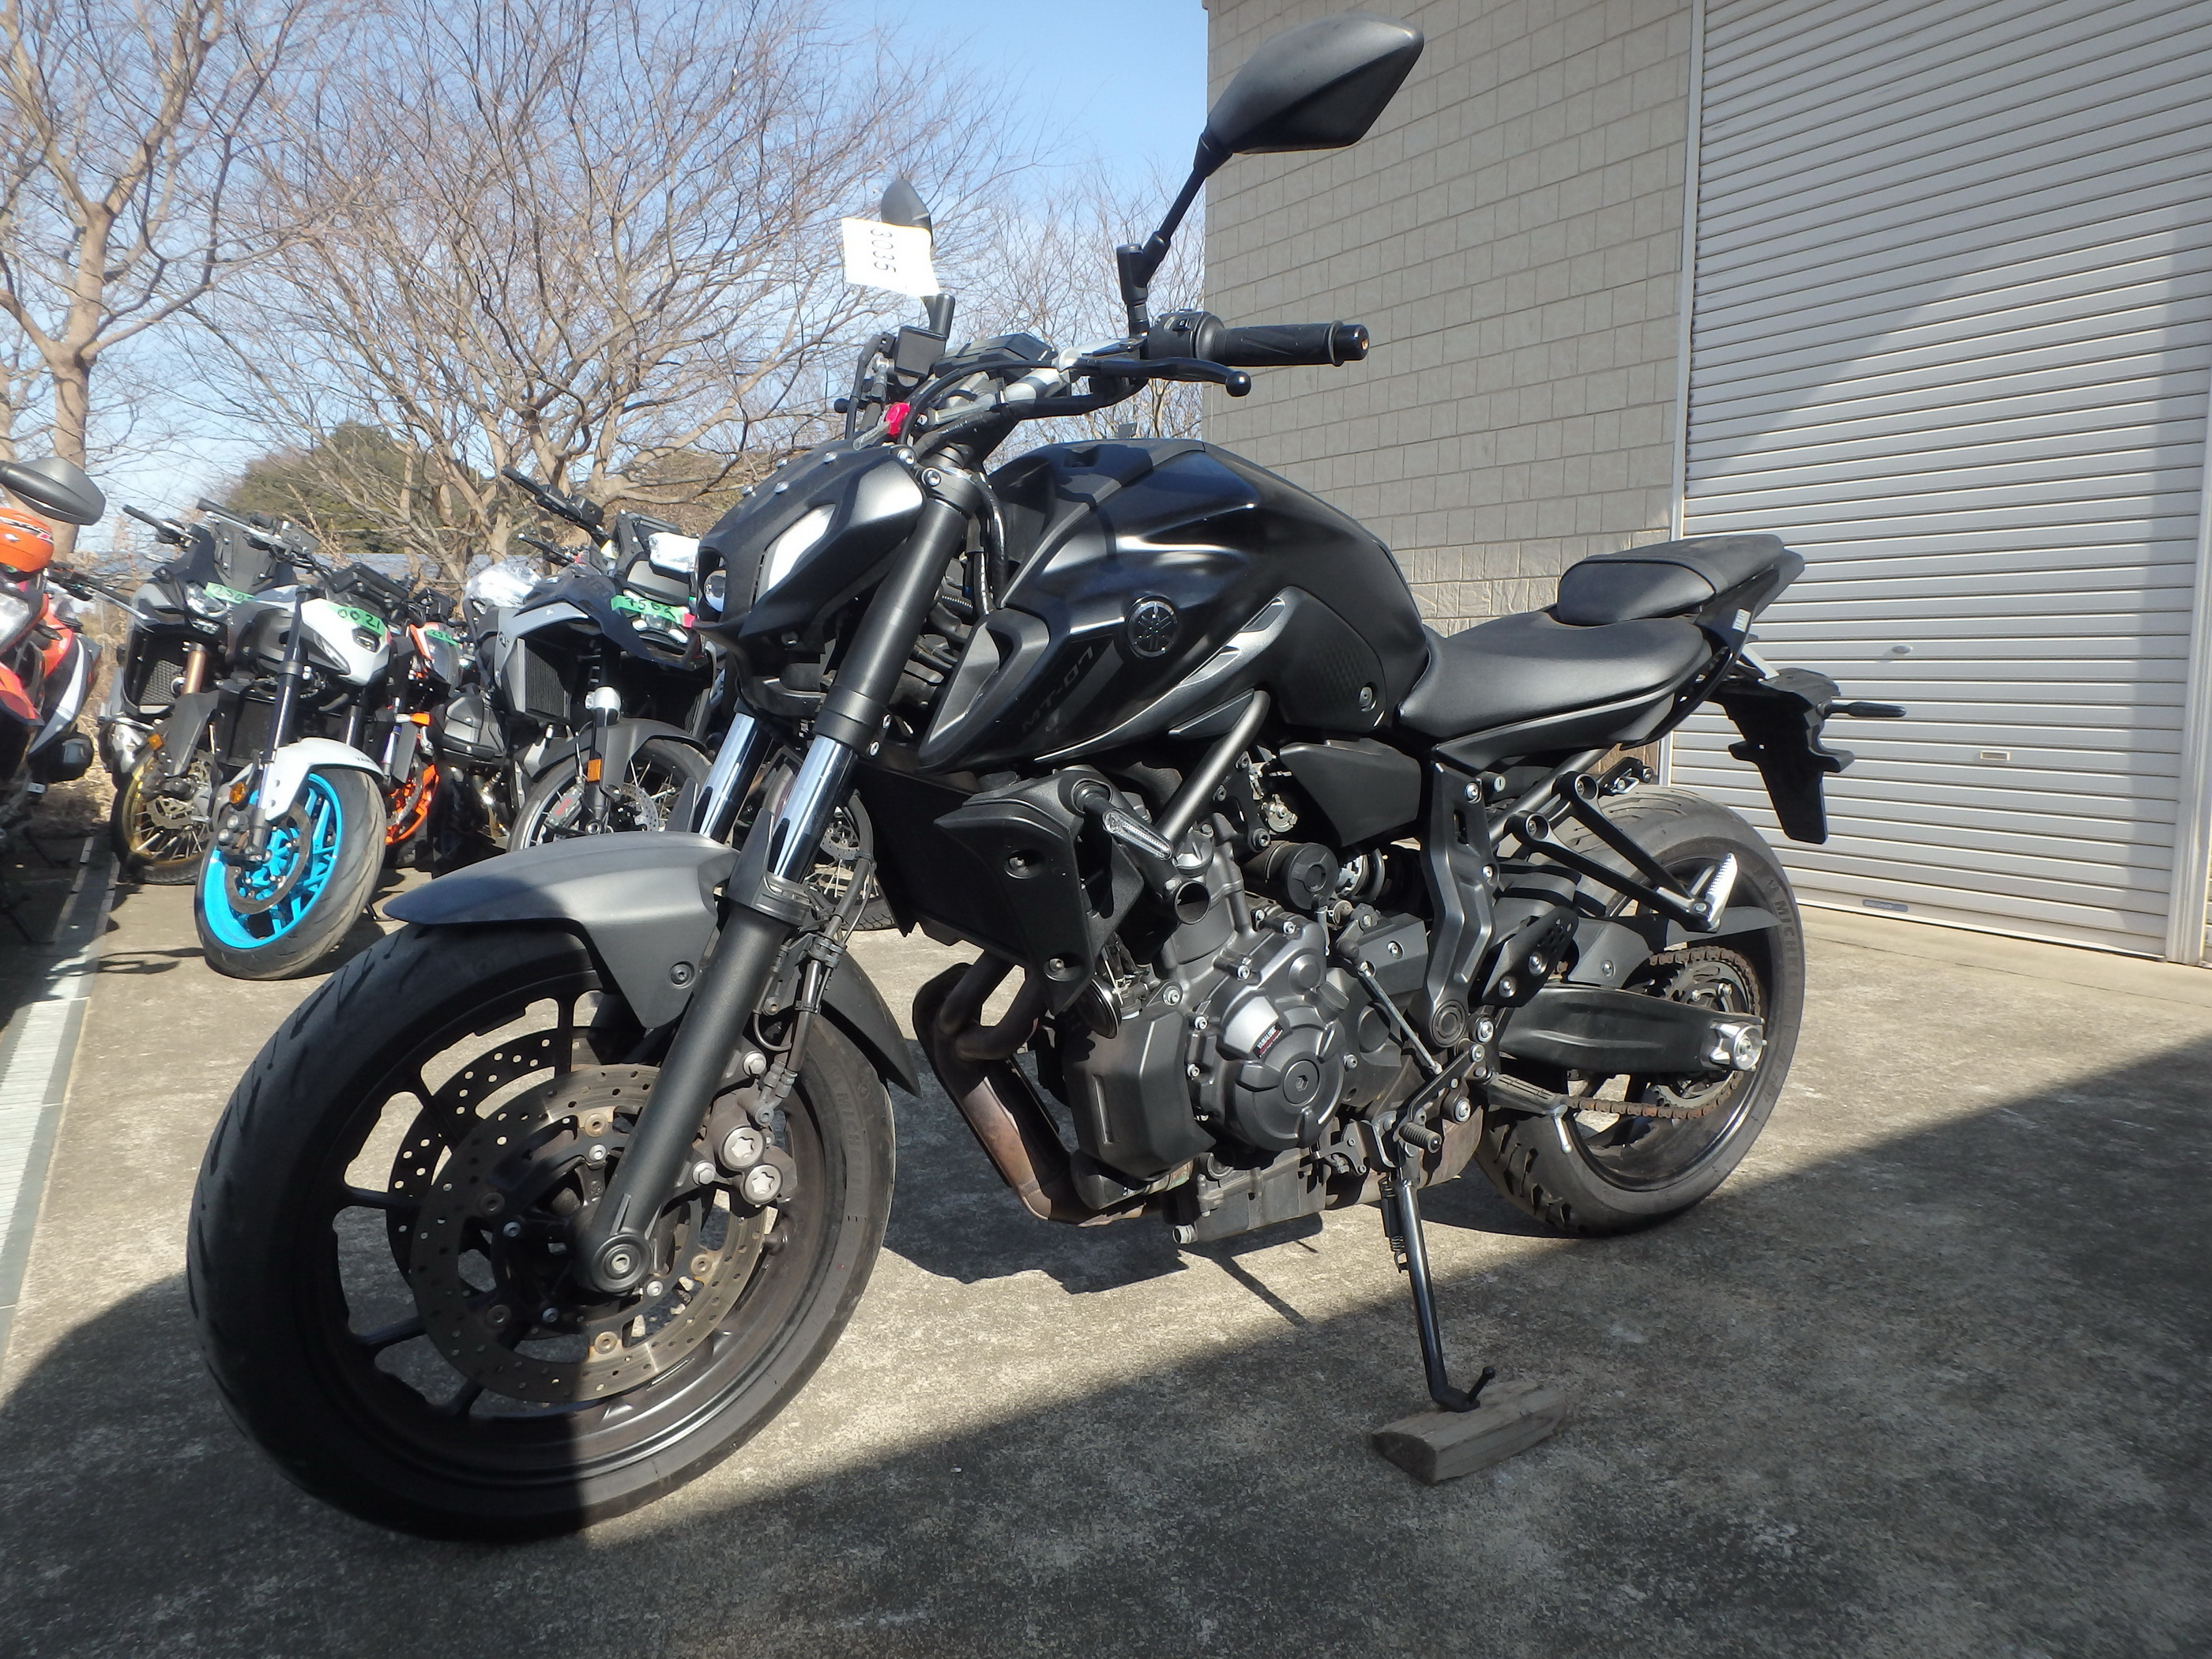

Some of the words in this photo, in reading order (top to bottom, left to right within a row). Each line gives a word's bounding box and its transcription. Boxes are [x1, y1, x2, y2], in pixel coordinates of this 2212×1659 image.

[871, 228, 897, 273] 3035
[213, 585, 254, 601] 250
[337, 608, 381, 630] 0021
[1022, 645, 1093, 732] MT-07
